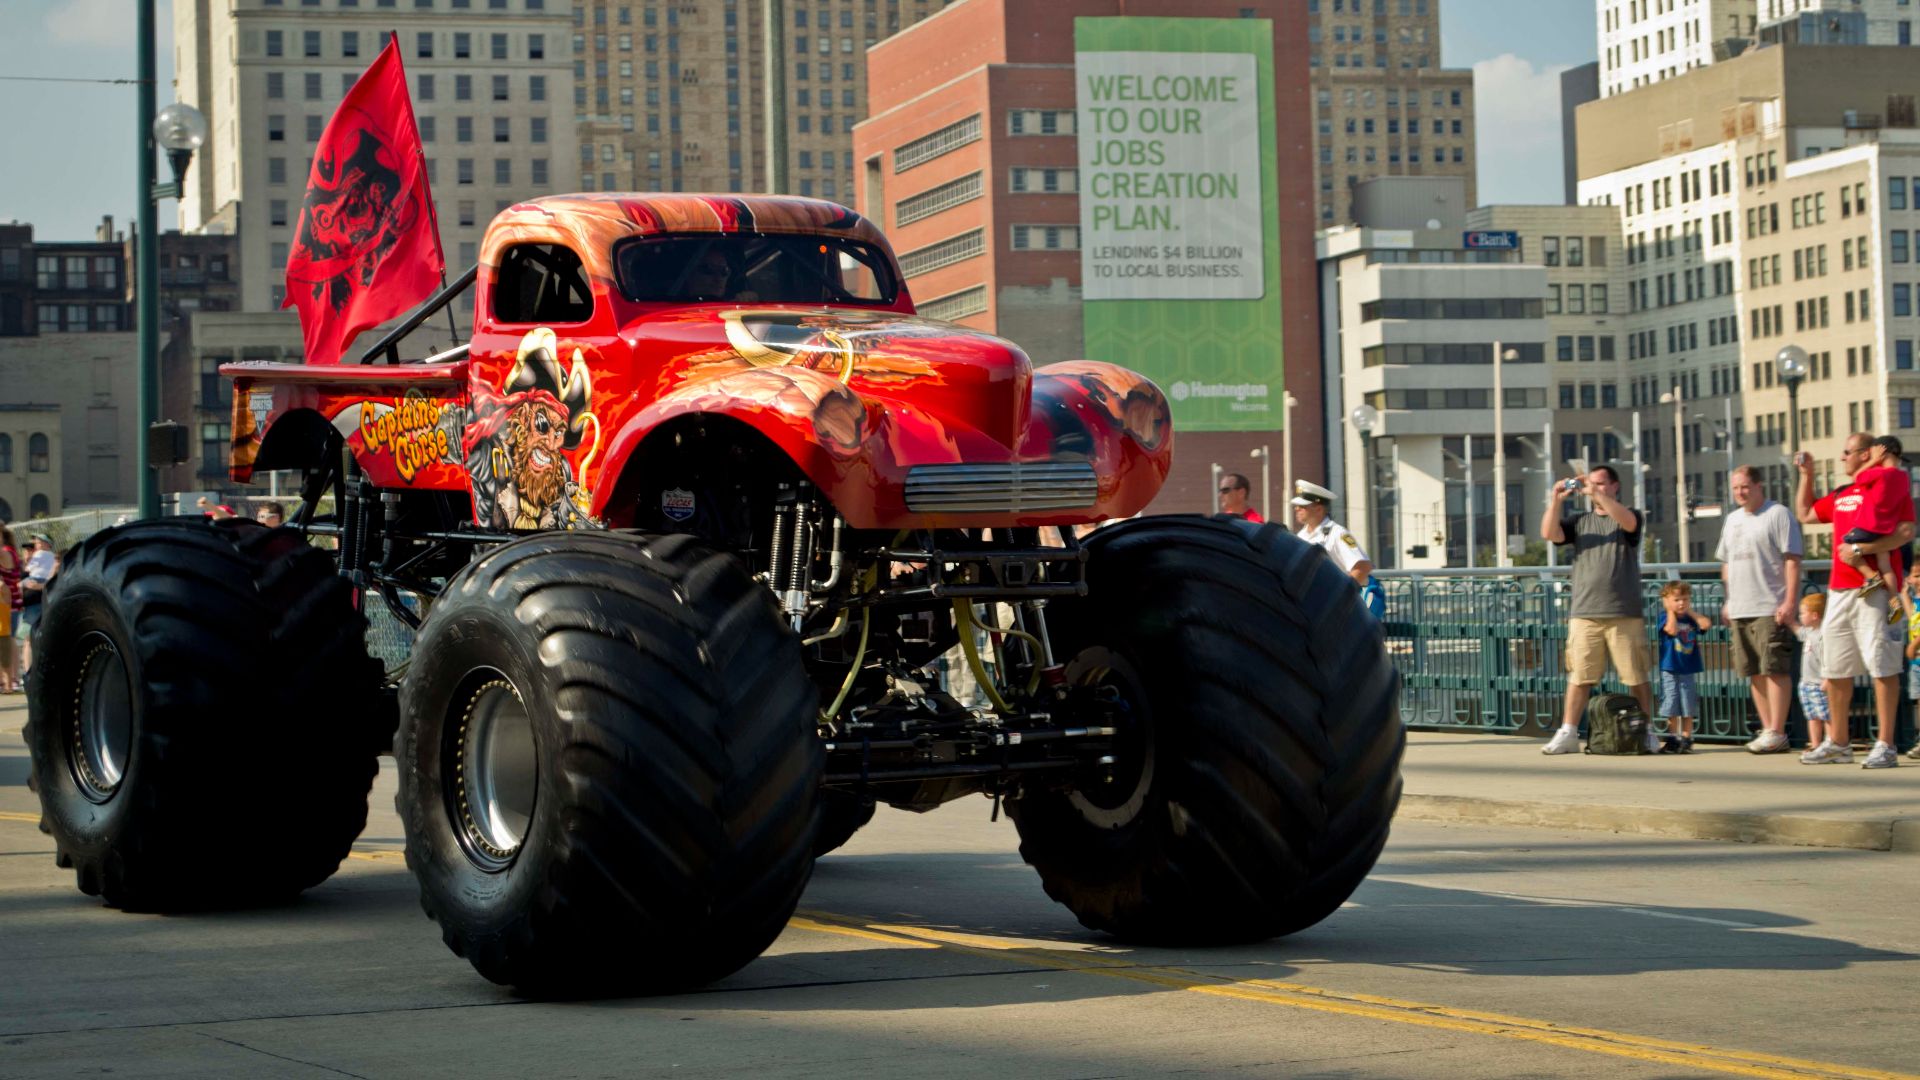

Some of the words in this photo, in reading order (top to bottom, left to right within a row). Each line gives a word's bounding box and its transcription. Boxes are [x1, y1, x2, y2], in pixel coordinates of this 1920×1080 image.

[1088, 75, 1237, 102] WELCOME
[1089, 108, 1129, 133] TO
[1138, 109, 1202, 134] OUR
[1090, 140, 1165, 166] JOBS
[1091, 172, 1239, 199] CREATION
[1093, 205, 1180, 231] PLAN.
[1093, 246, 1158, 260] LENDING
[1163, 247, 1181, 260] $4
[1186, 247, 1243, 260] BILLION
[1094, 265, 1113, 278] TO
[1117, 265, 1162, 278] LOCAL
[1166, 265, 1243, 279] BUSINESS.
[1191, 381, 1267, 401] Huntington
[395, 429, 449, 486] Curse
